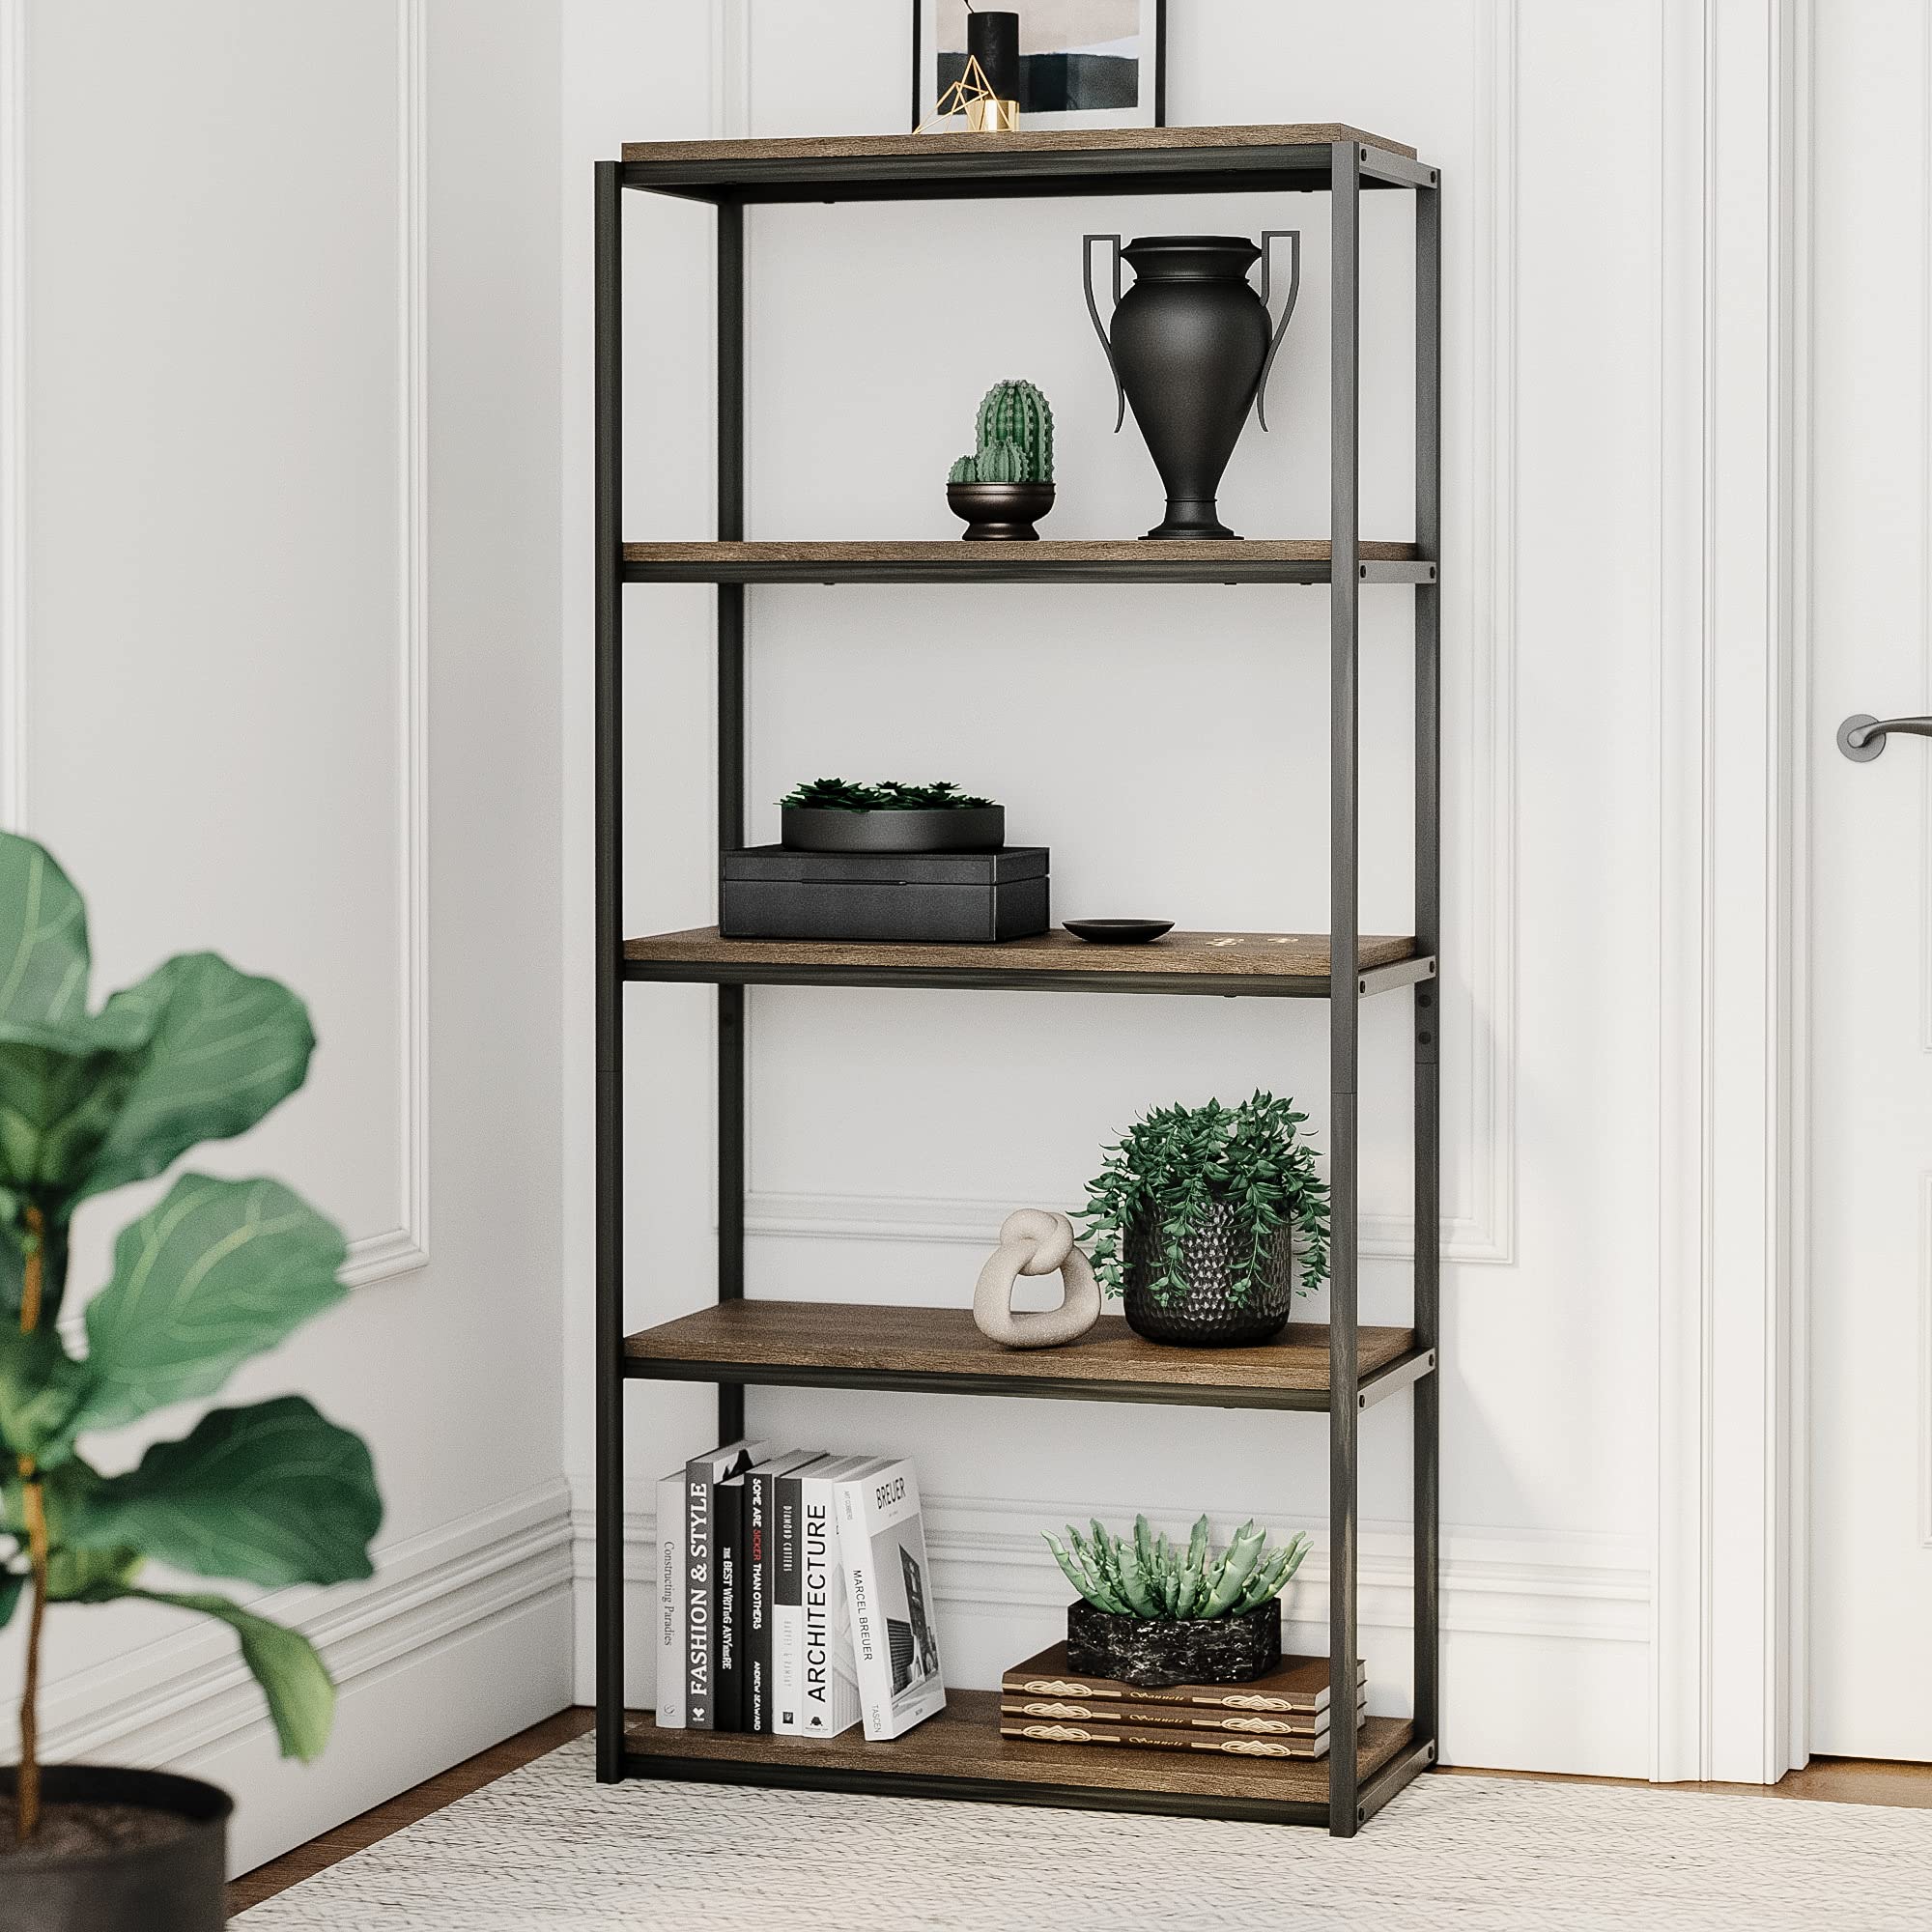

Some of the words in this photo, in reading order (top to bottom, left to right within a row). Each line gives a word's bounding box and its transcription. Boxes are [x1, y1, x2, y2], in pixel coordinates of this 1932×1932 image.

[753, 1478, 762, 1506] SOME
[876, 1477, 906, 1509] BREUER
[690, 1482, 707, 1558] STYLE
[753, 1506, 762, 1528] ARE
[782, 1505, 793, 1540] DIAMOND
[753, 1529, 761, 1561] SICKER
[661, 1541, 675, 1604] Constructing
[690, 1563, 707, 1582] &
[723, 1560, 733, 1587] BEST
[753, 1562, 762, 1591] THAN
[807, 1504, 826, 1703] ARCHITECTURE
[853, 1570, 867, 1614] MARCEL
[753, 1591, 762, 1630] OTHERS
[690, 1588, 707, 1696] FASHION
[859, 1616, 873, 1661] BREUER
